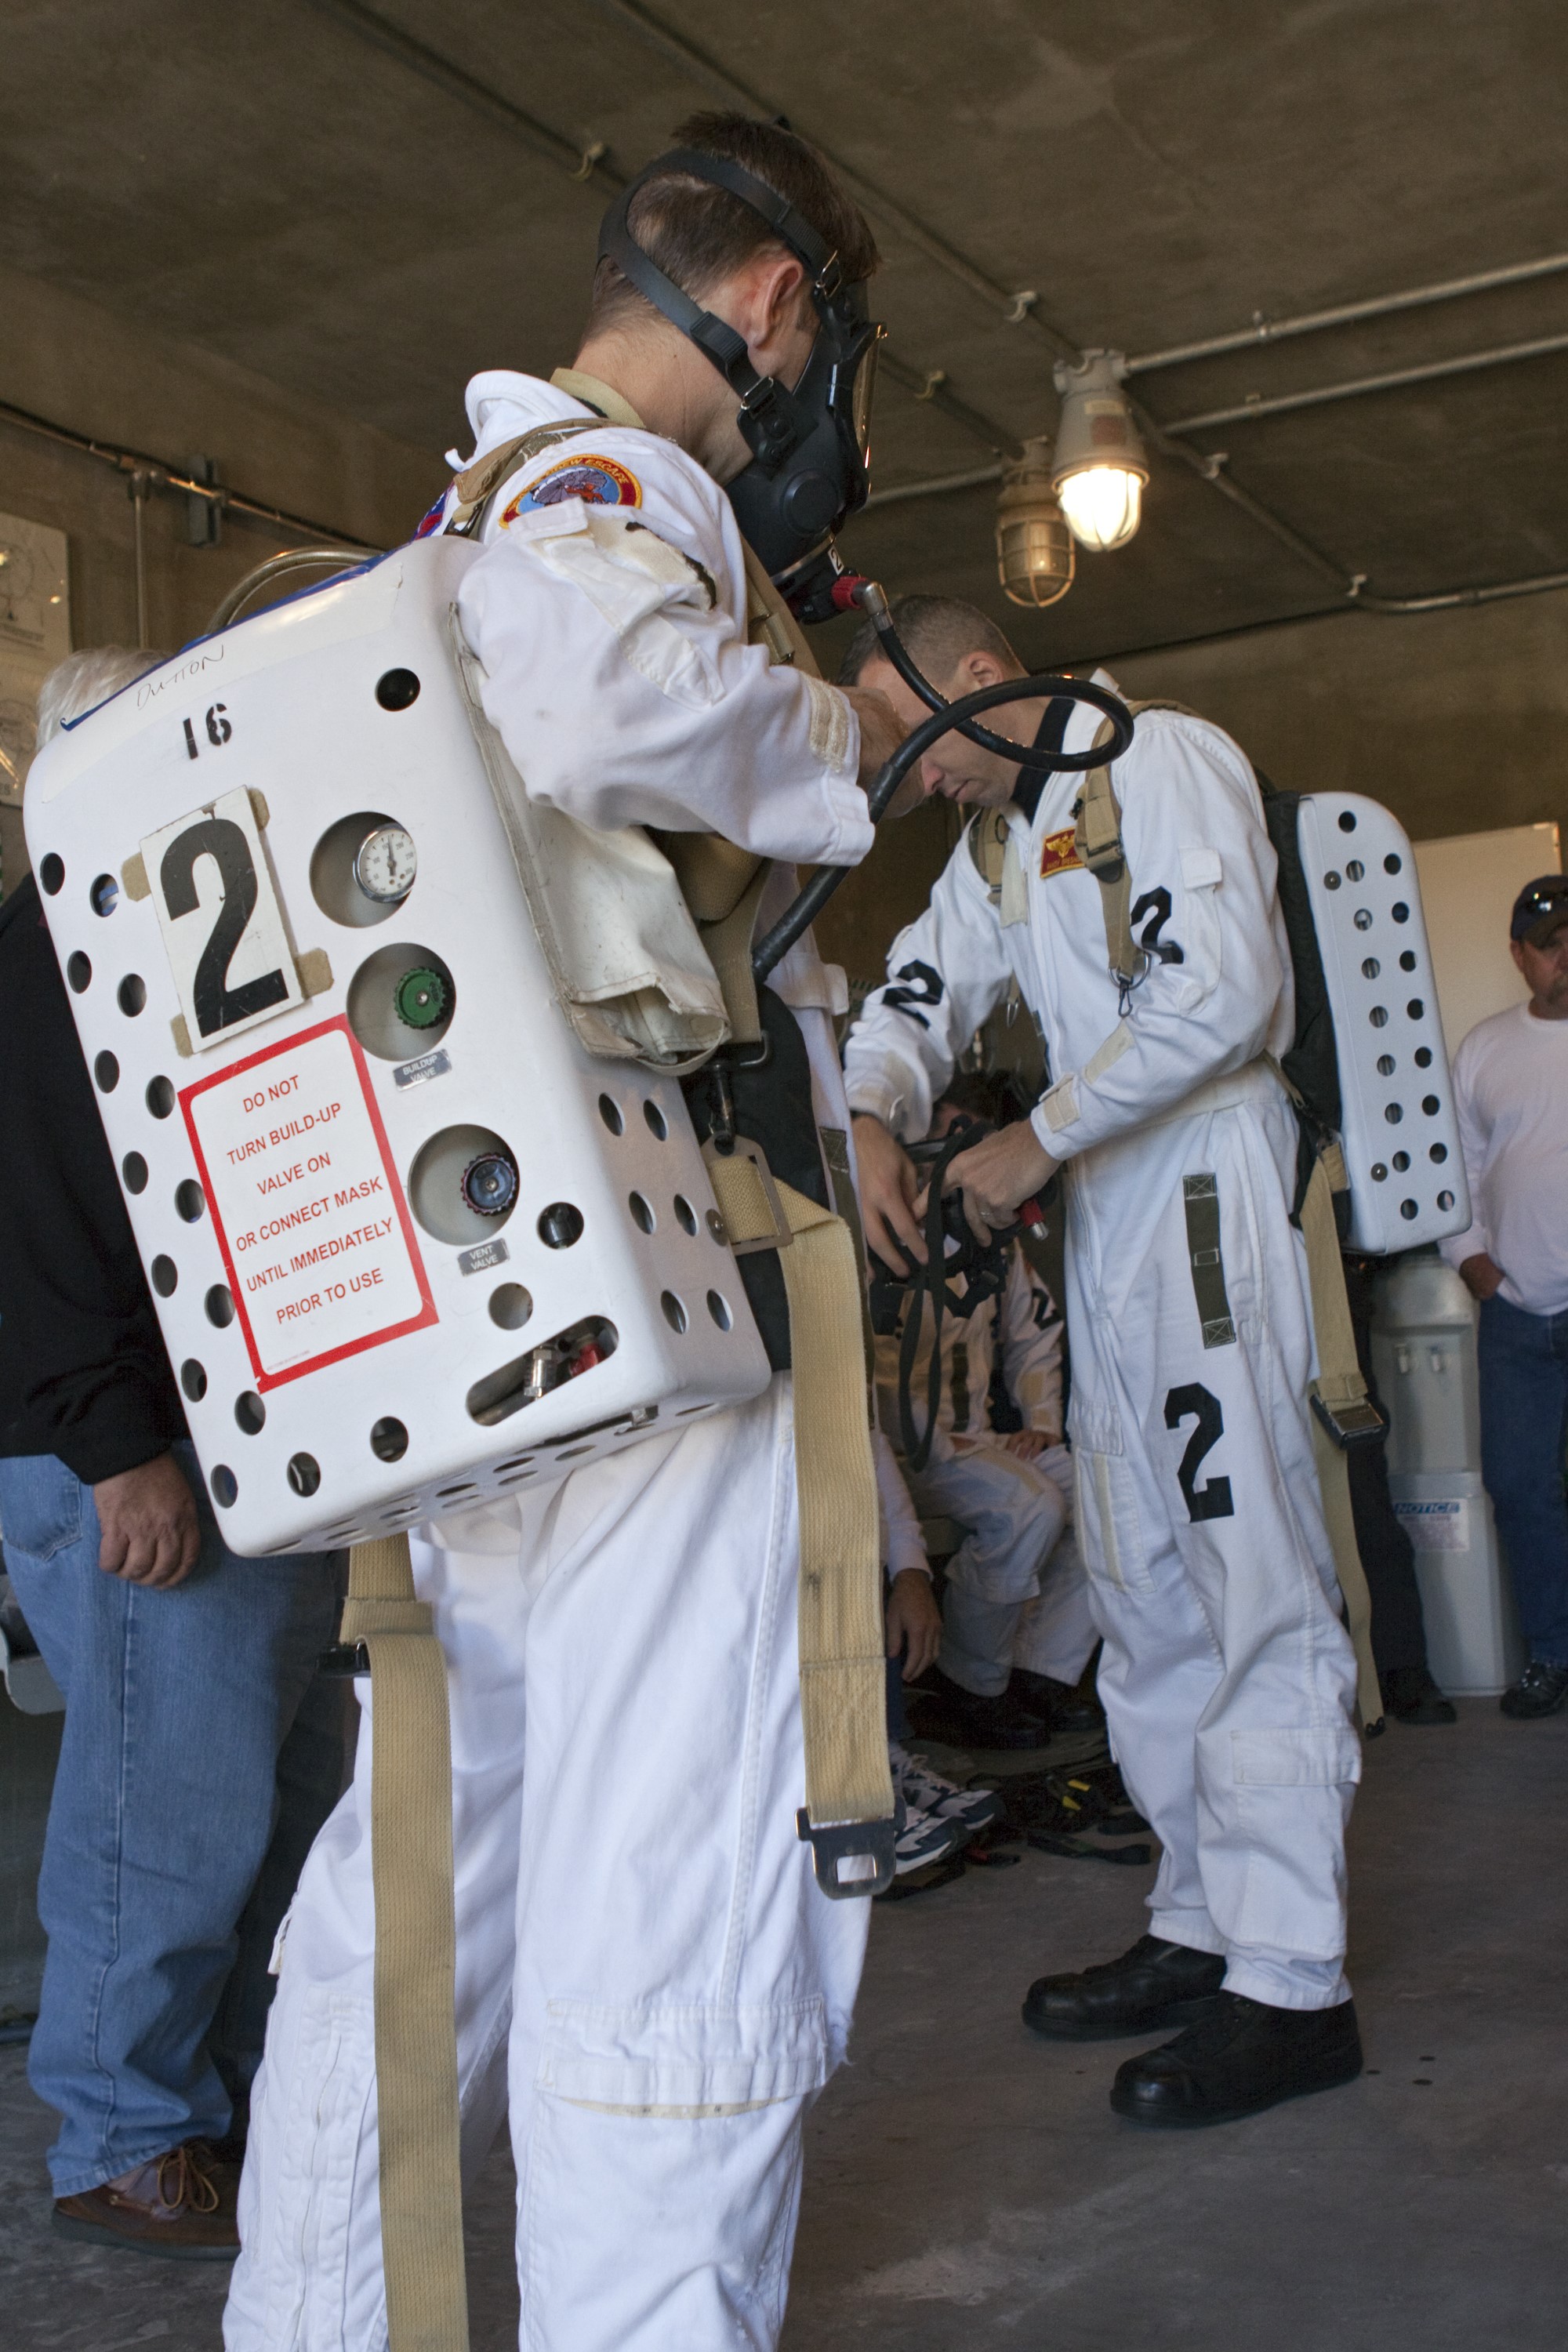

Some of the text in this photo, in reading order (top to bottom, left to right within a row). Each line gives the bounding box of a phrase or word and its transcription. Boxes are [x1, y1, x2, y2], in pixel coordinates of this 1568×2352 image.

[585, 459, 629, 484] ESCAPE
[831, 550, 842, 571] 2
[183, 703, 232, 760] 16
[160, 818, 289, 1038] 2
[1131, 885, 1184, 964] 2
[881, 959, 944, 1031] 2
[402, 1054, 437, 1076] BUILDUP
[410, 1067, 436, 1083] VALVE
[243, 1075, 299, 1112] DO NOT
[227, 1103, 341, 1165] TURN BUILD-UP
[257, 1152, 331, 1195] VALVE ON
[236, 1176, 383, 1251] OR CONNECT MASK
[247, 1218, 392, 1291] UNTIL IMMEDIATELY
[470, 1245, 493, 1260] VENT
[470, 1254, 499, 1270] VALVE
[277, 1268, 383, 1324] PRIOR TO USE
[1164, 1381, 1235, 1523] 2
[1395, 1502, 1459, 1514] NOTICE
